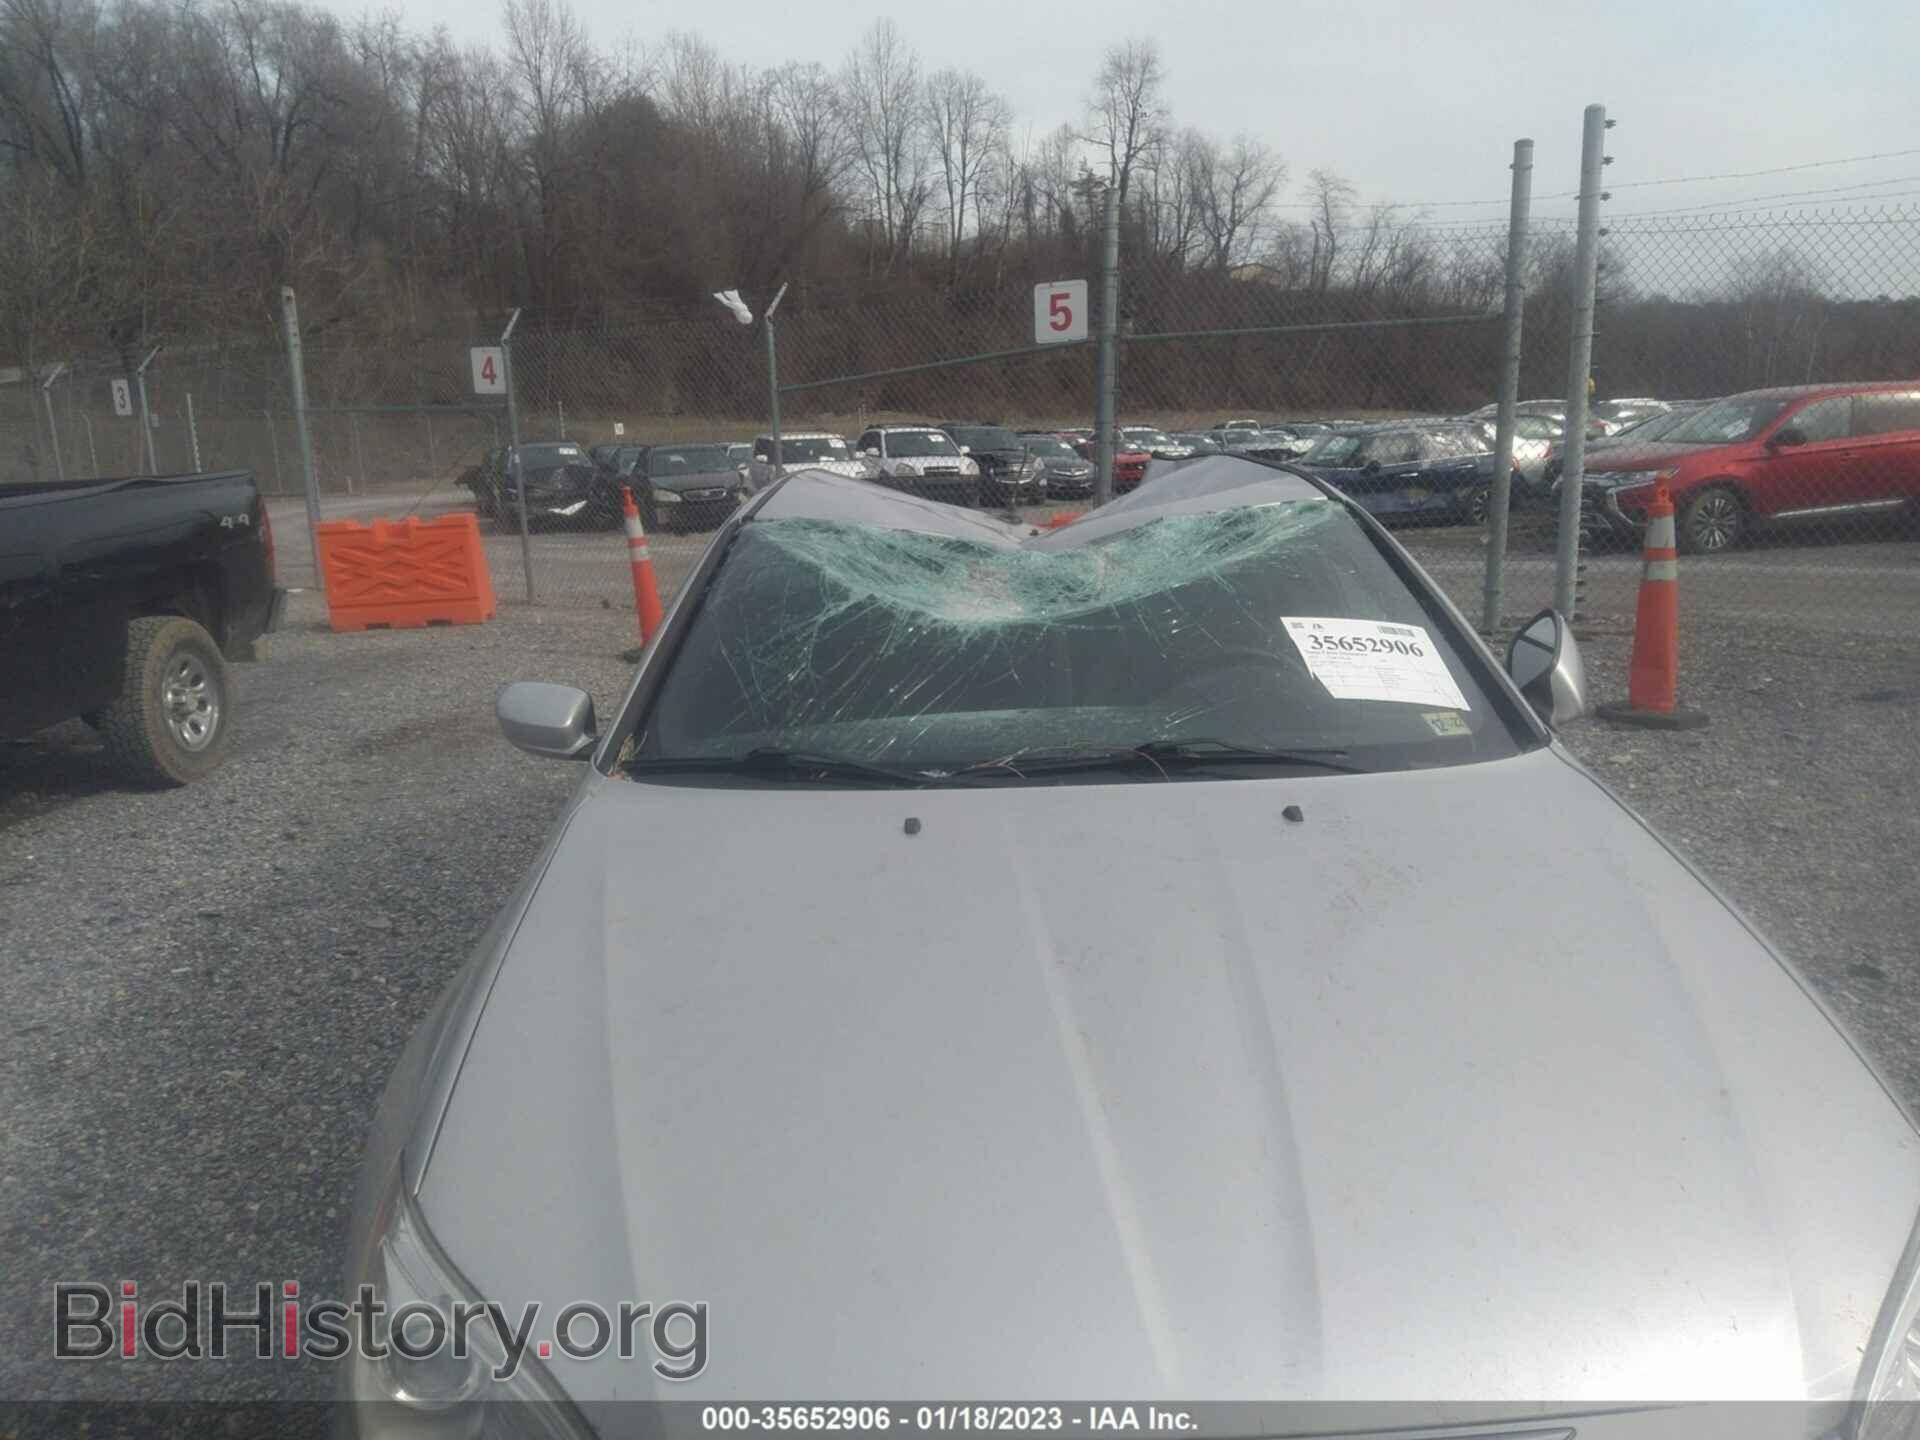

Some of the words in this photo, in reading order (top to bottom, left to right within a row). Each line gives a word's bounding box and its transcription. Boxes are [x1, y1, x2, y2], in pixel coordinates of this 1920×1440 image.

[1049, 292, 1073, 331] 5
[481, 354, 497, 385] 4
[1307, 634, 1424, 657] 35652906
